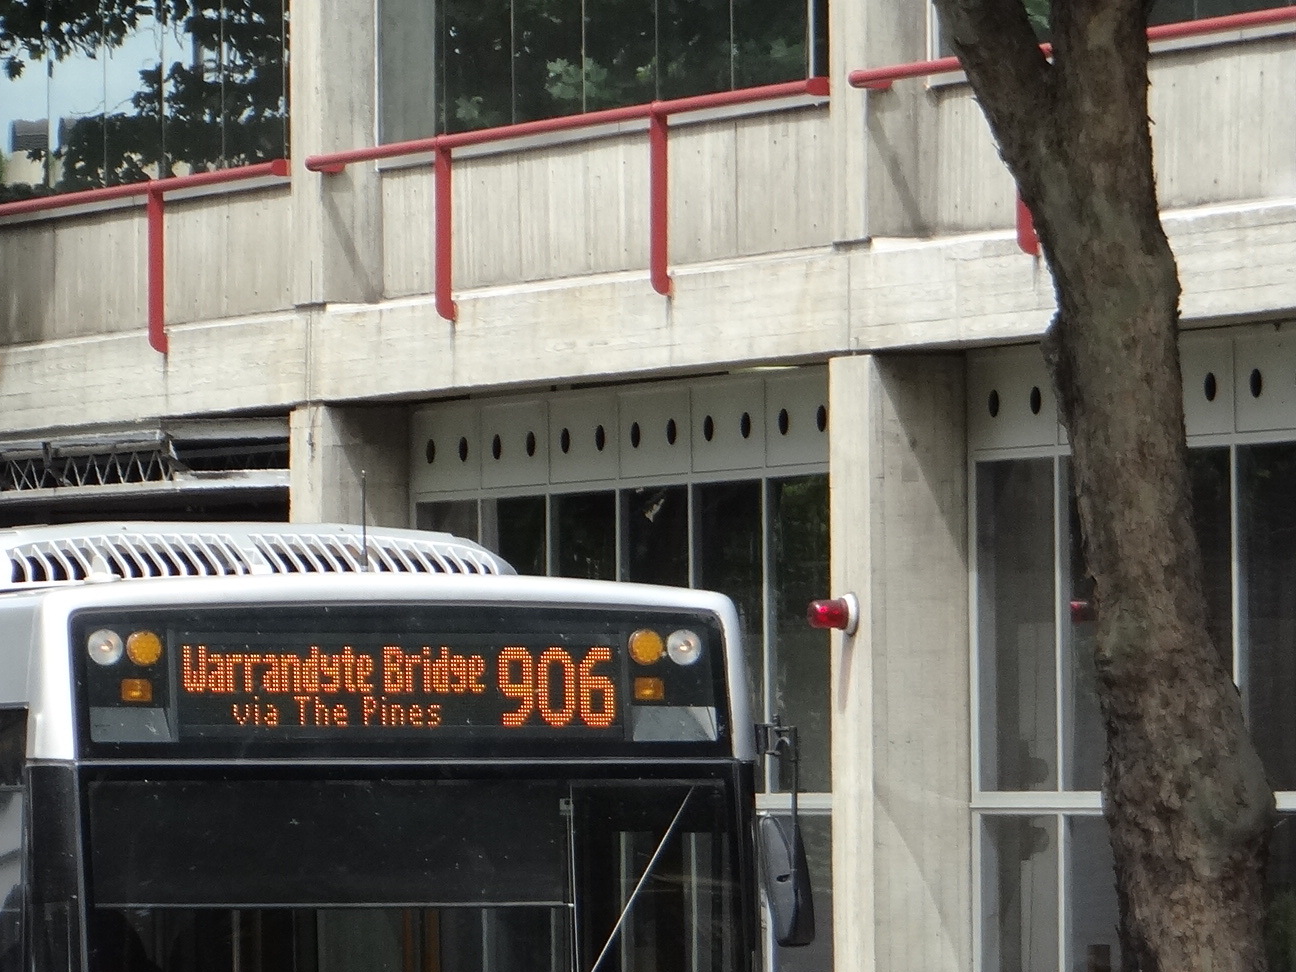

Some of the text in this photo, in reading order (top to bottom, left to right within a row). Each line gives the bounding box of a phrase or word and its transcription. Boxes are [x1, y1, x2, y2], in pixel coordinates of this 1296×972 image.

[182, 645, 486, 692] Warrandyte Bridge
[498, 647, 615, 727] 906
[232, 695, 442, 726] via The Pines
